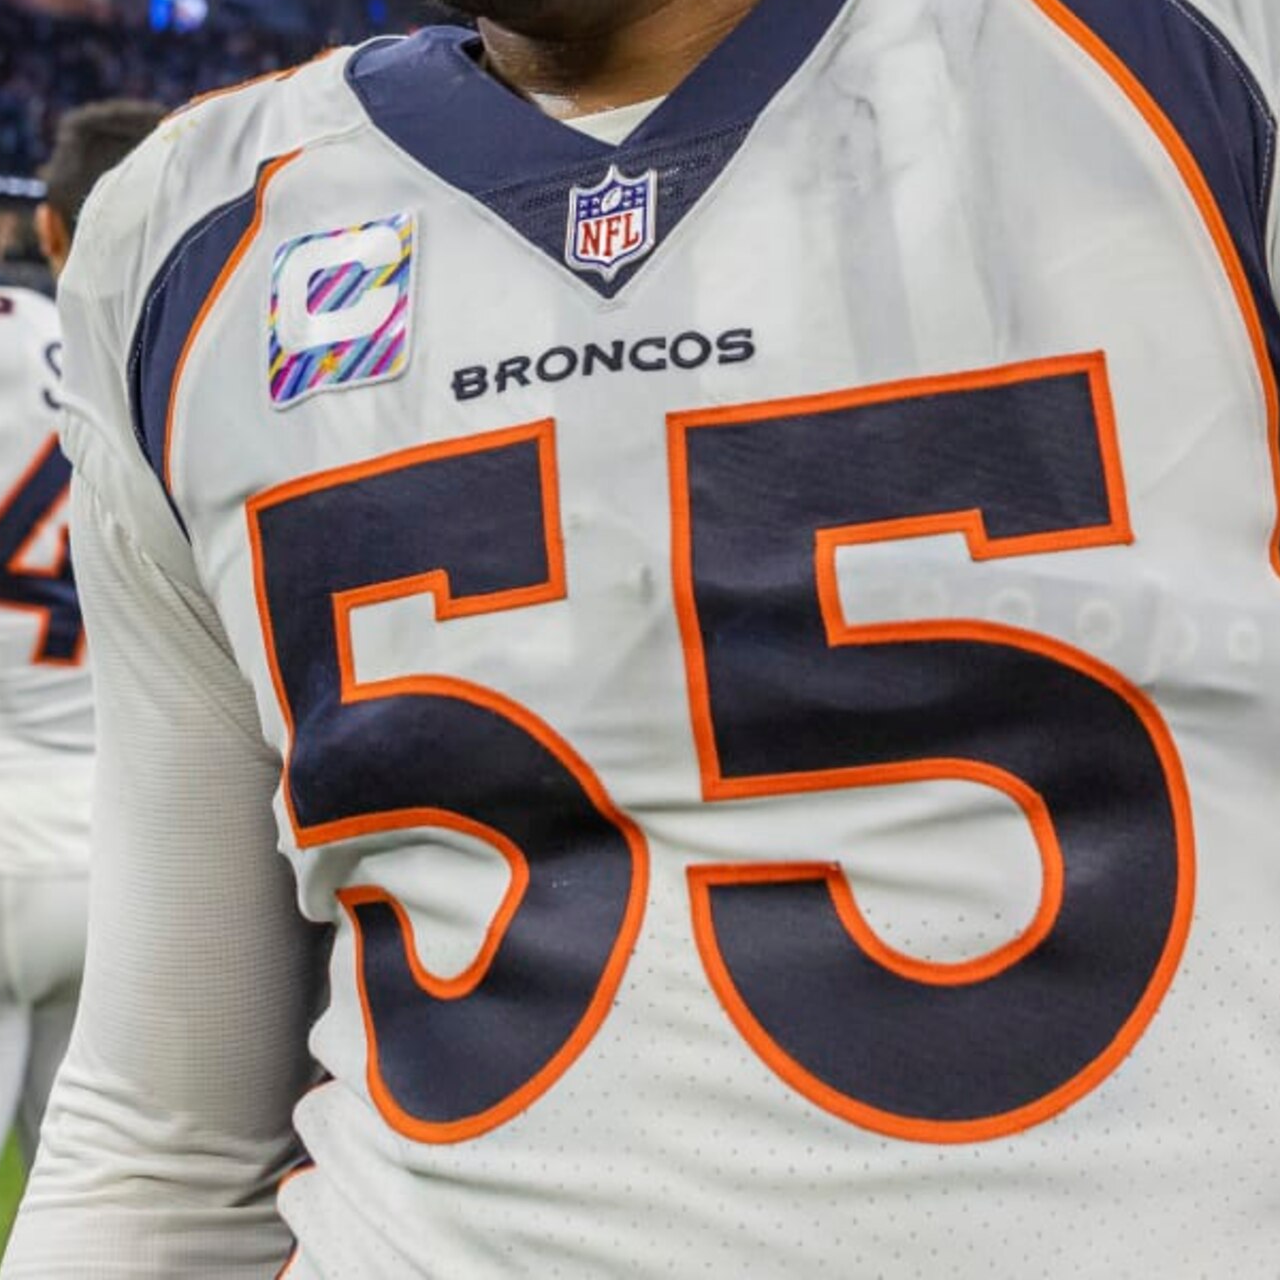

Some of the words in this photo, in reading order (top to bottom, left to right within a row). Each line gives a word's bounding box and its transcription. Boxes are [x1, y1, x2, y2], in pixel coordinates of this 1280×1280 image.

[580, 213, 639, 258] NFL
[451, 328, 756, 402] BRONCOS
[245, 350, 1197, 1145] 55
